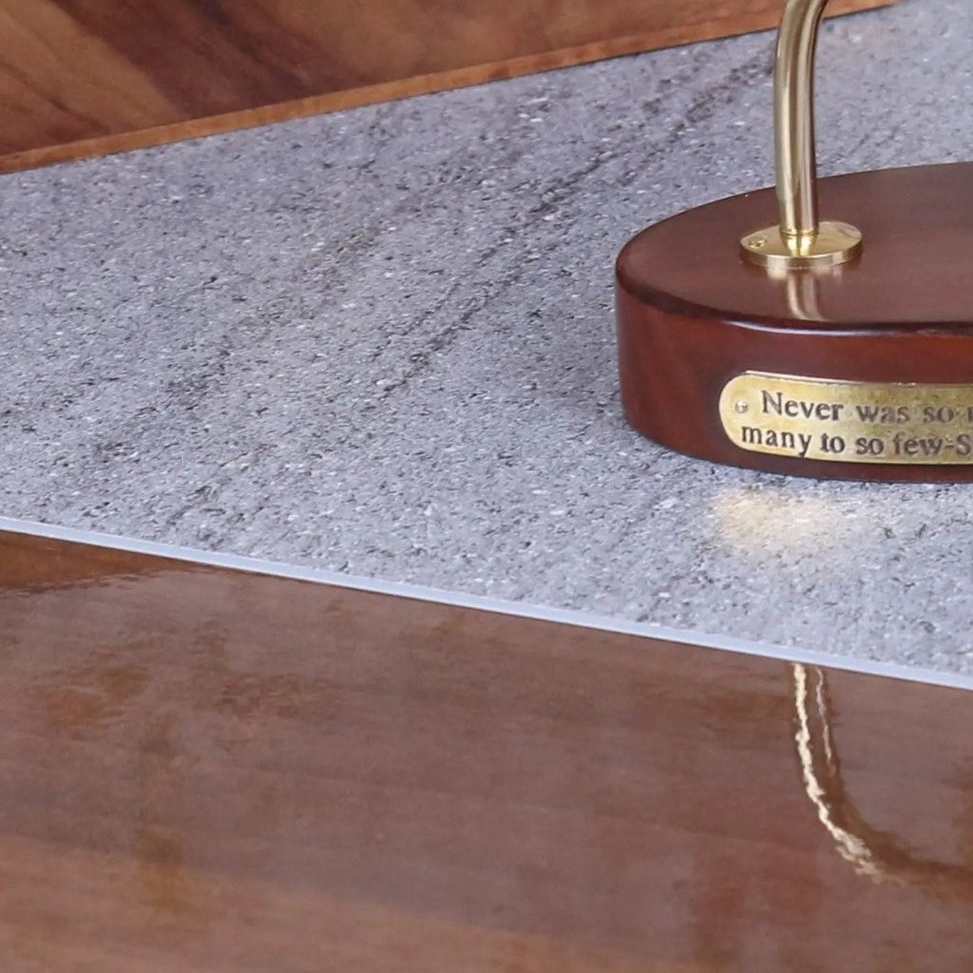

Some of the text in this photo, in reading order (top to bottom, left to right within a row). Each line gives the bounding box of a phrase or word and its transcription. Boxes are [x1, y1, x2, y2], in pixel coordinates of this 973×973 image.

[761, 389, 844, 421] Never
[856, 404, 910, 424] was
[923, 405, 954, 424] so
[741, 425, 812, 458] many
[820, 434, 845, 454] to
[855, 437, 884, 456] so
